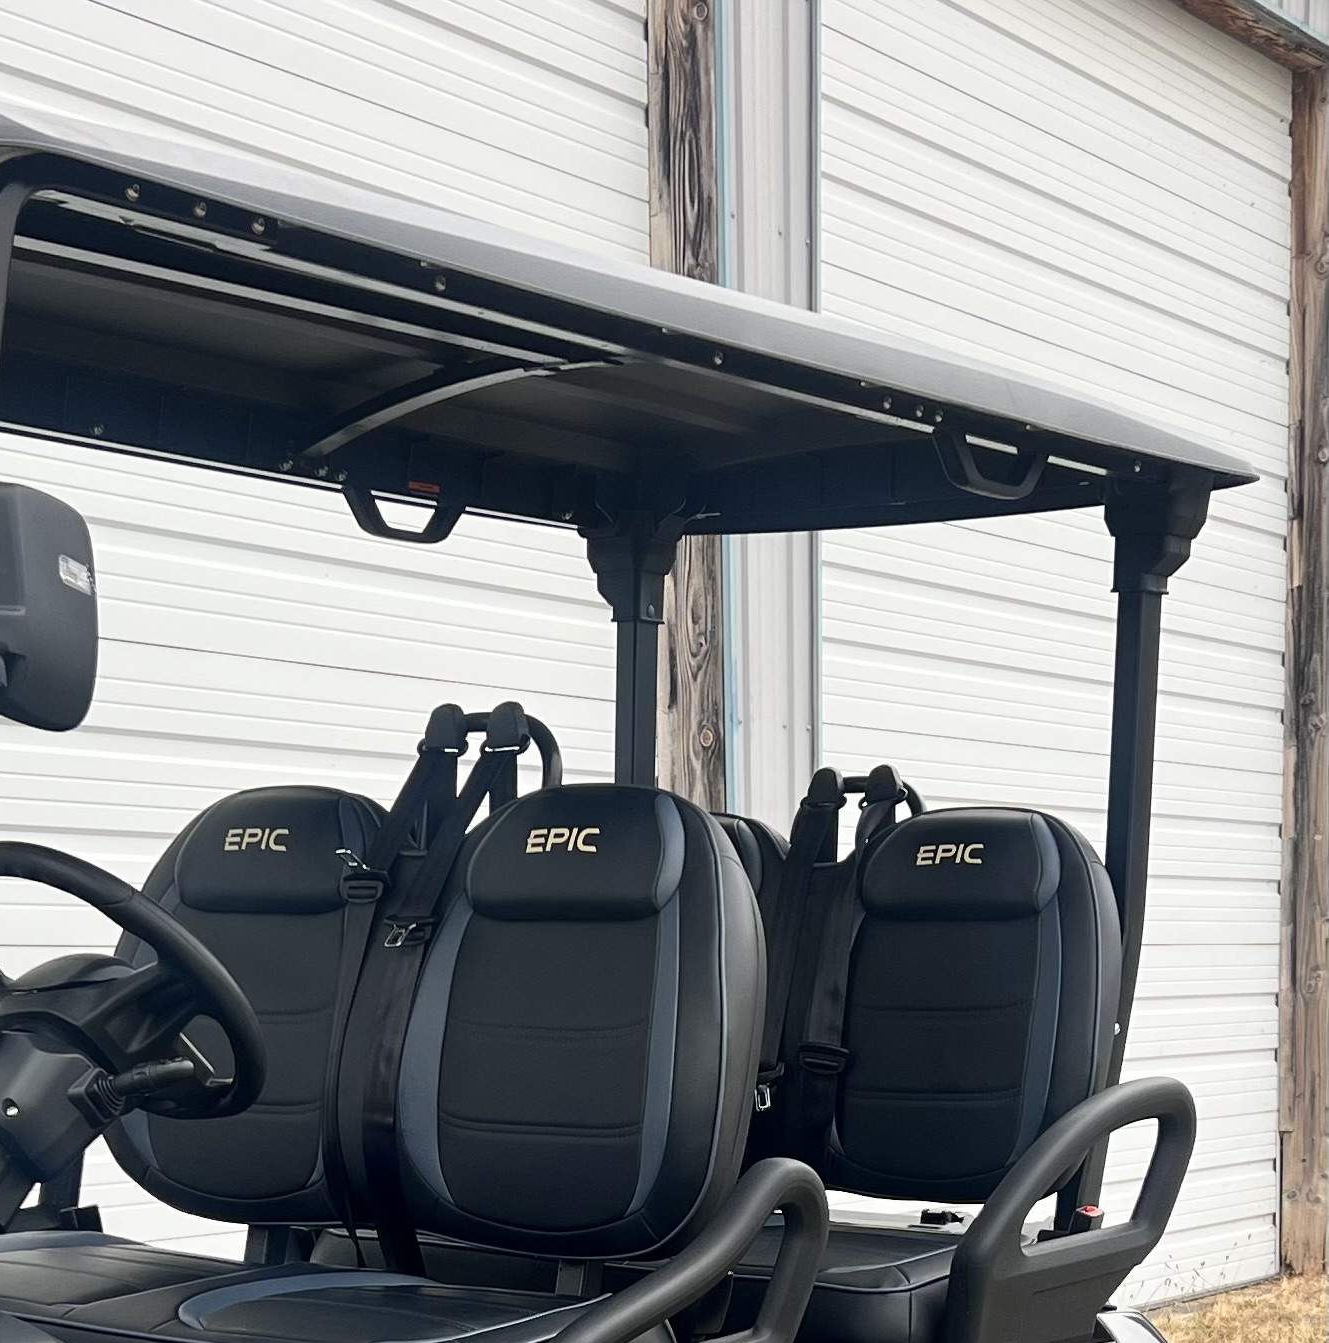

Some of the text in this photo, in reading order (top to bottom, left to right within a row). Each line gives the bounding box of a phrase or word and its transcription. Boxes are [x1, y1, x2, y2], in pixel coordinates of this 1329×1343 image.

[223, 828, 290, 852] EPIC
[525, 827, 601, 854] EPIC
[916, 843, 984, 866] EPIC
